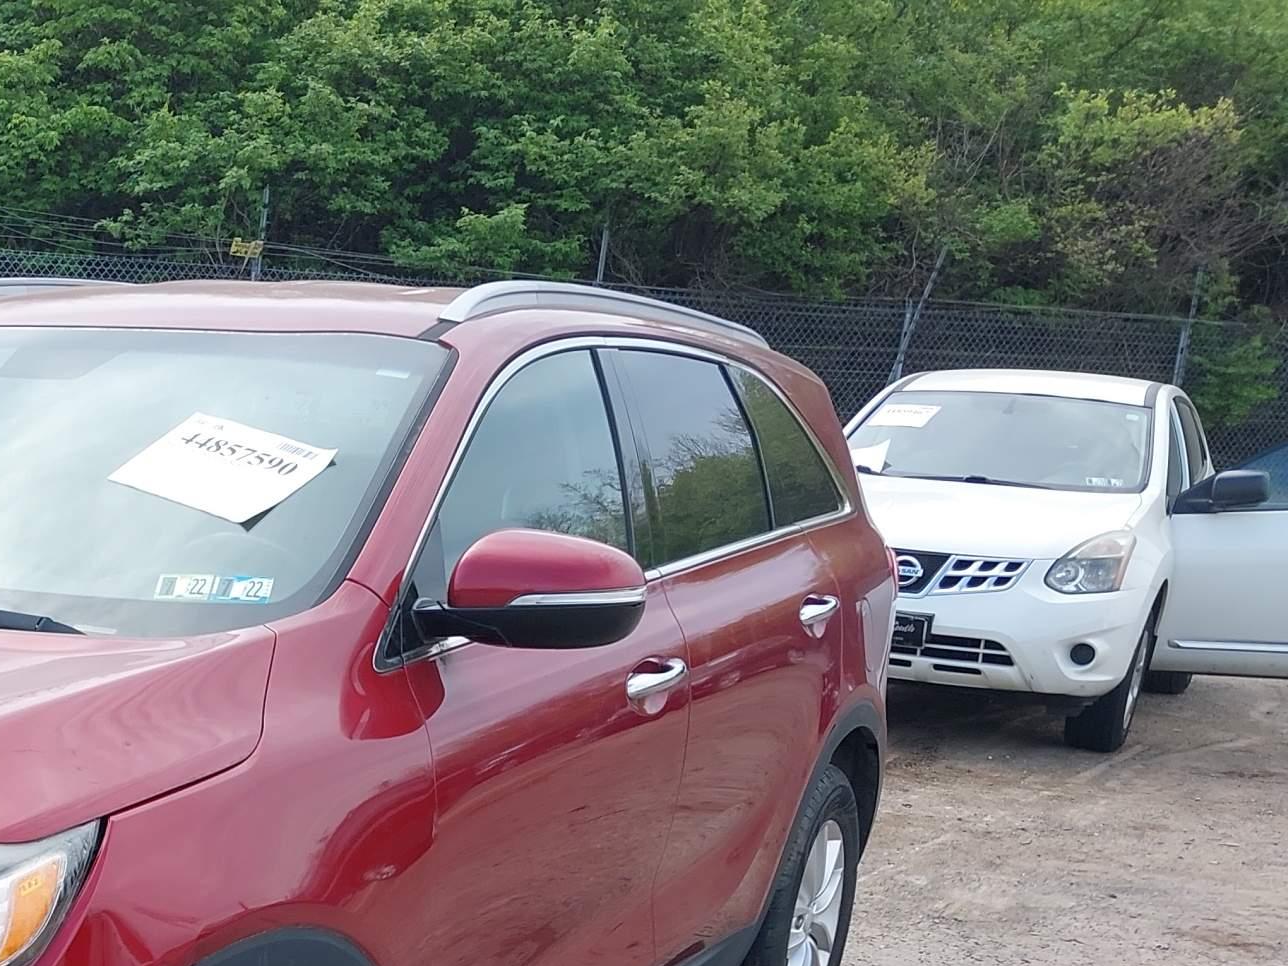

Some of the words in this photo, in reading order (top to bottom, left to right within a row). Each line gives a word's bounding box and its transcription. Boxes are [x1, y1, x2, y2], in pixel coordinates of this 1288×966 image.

[182, 432, 298, 476] 44857590
[189, 578, 207, 595] 22
[245, 580, 264, 598] 22
